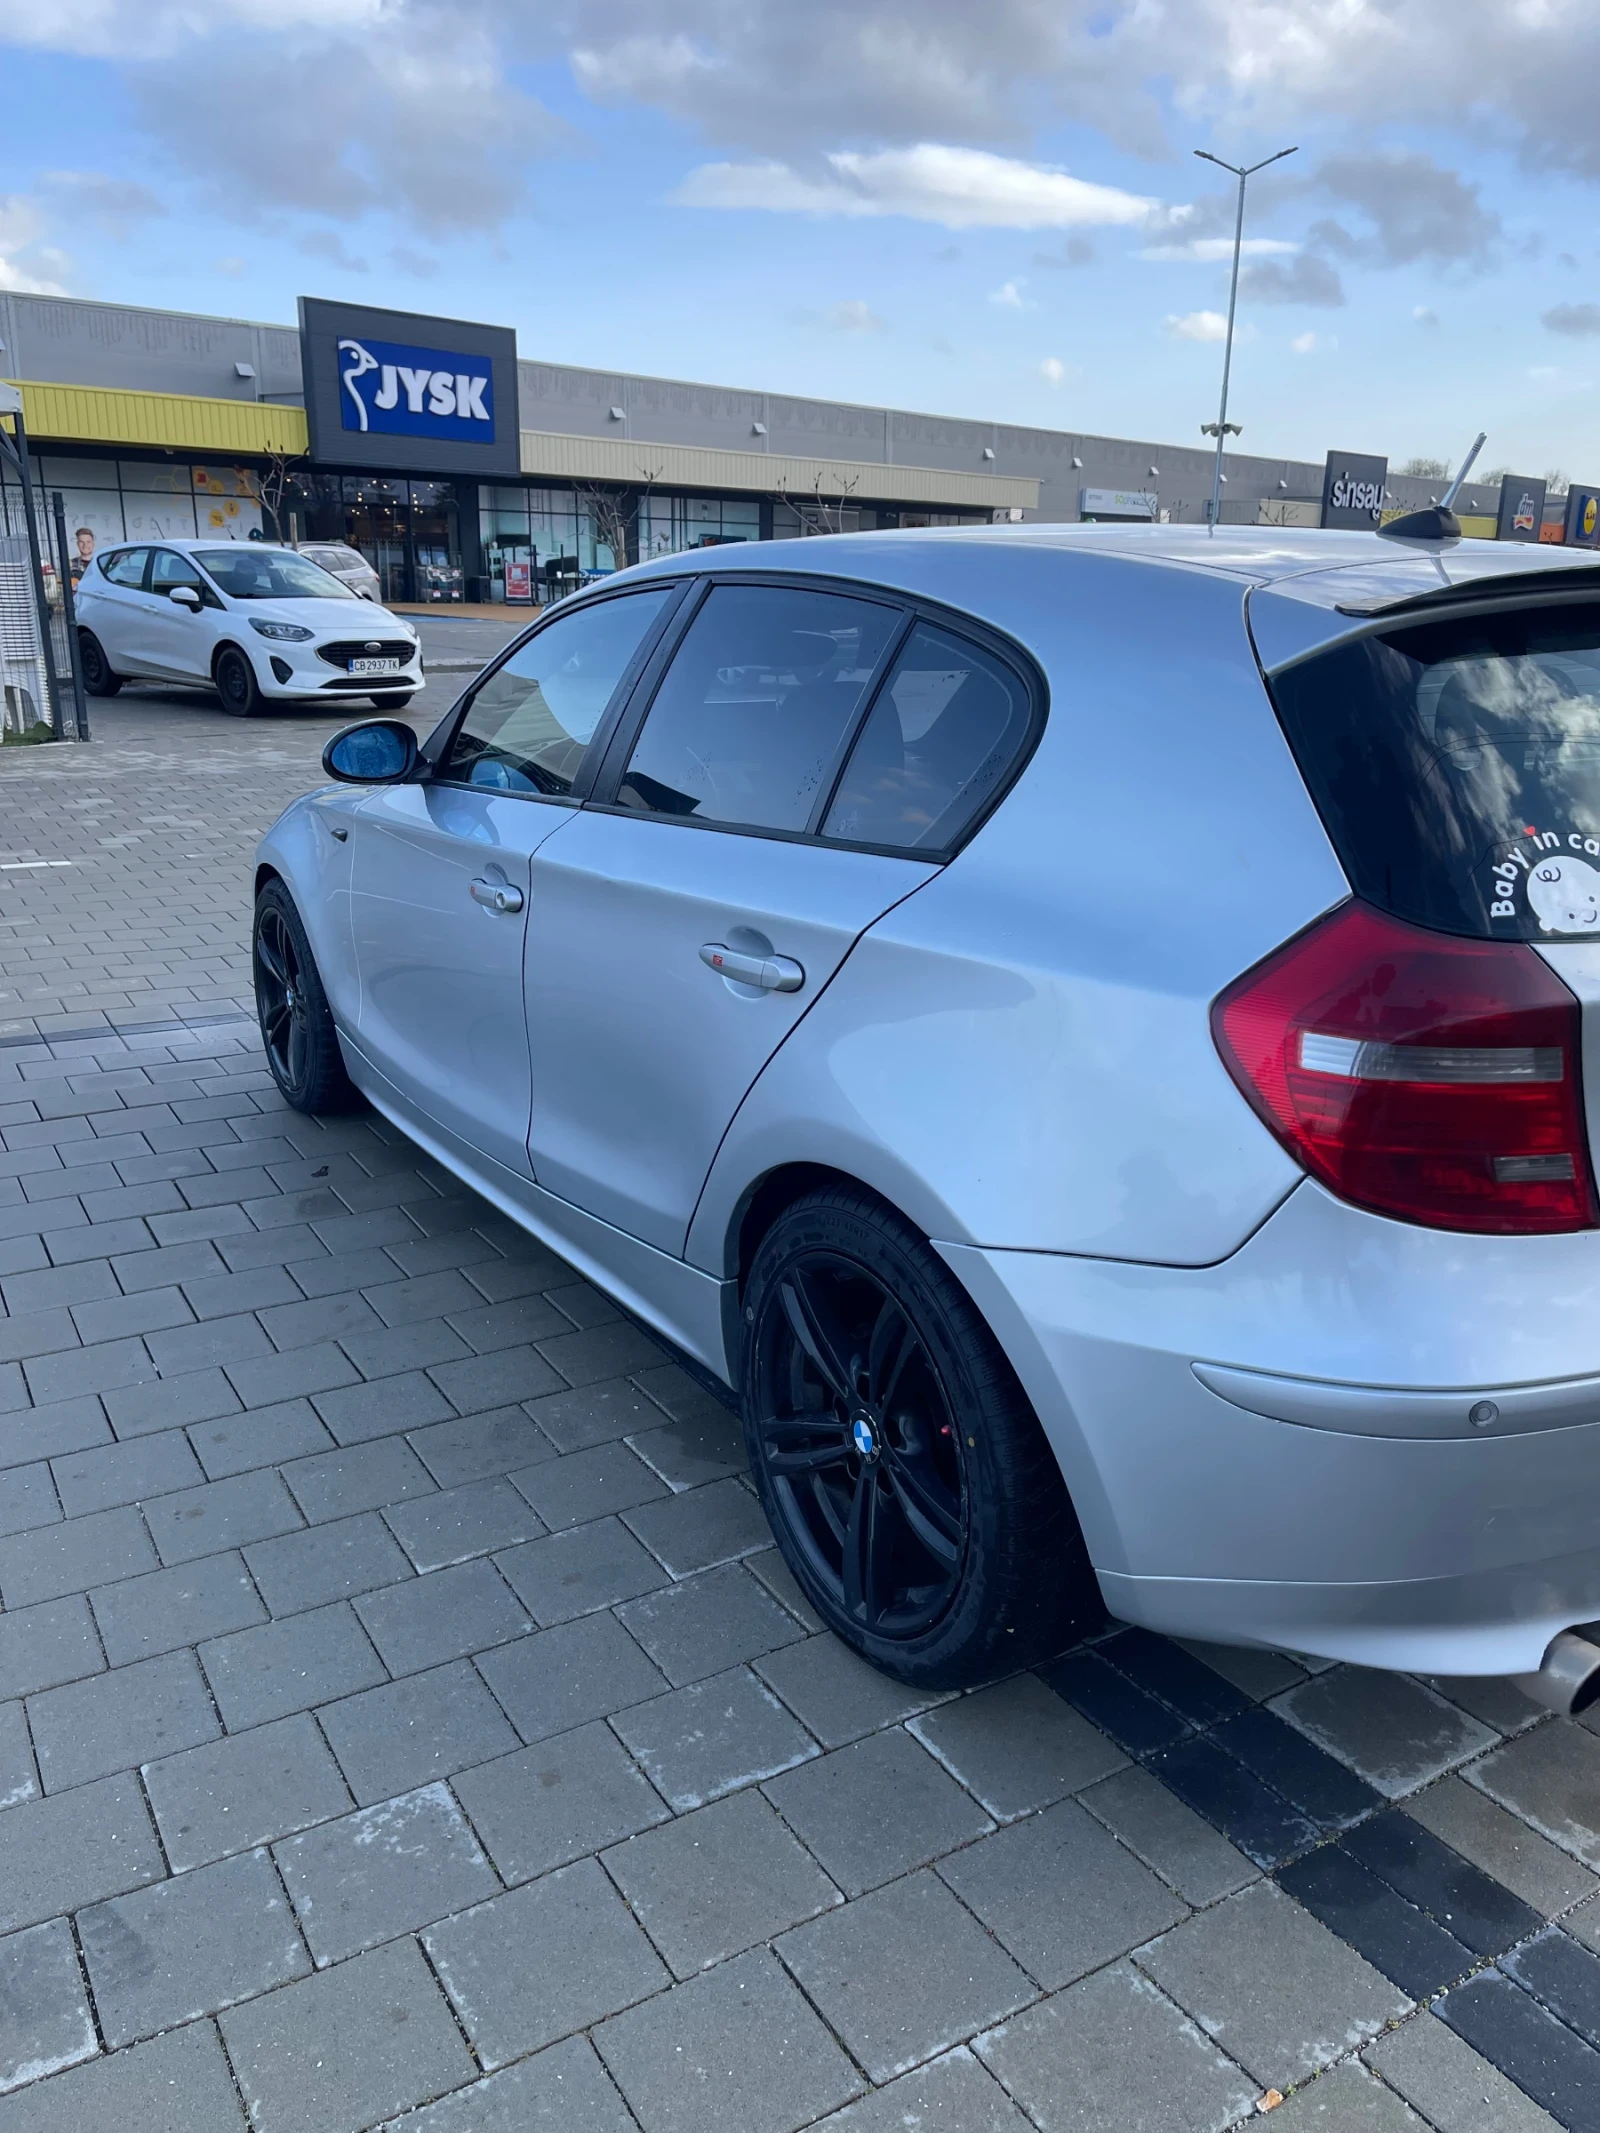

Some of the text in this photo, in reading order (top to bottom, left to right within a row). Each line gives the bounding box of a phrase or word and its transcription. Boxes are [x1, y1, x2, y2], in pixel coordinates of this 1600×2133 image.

[374, 364, 490, 420] JYSK
[1332, 471, 1385, 521] sinsay
[1518, 494, 1534, 516] dm
[354, 659, 398, 671] CB 2937 TK
[1490, 847, 1529, 918] Baby
[1527, 828, 1560, 850] in
